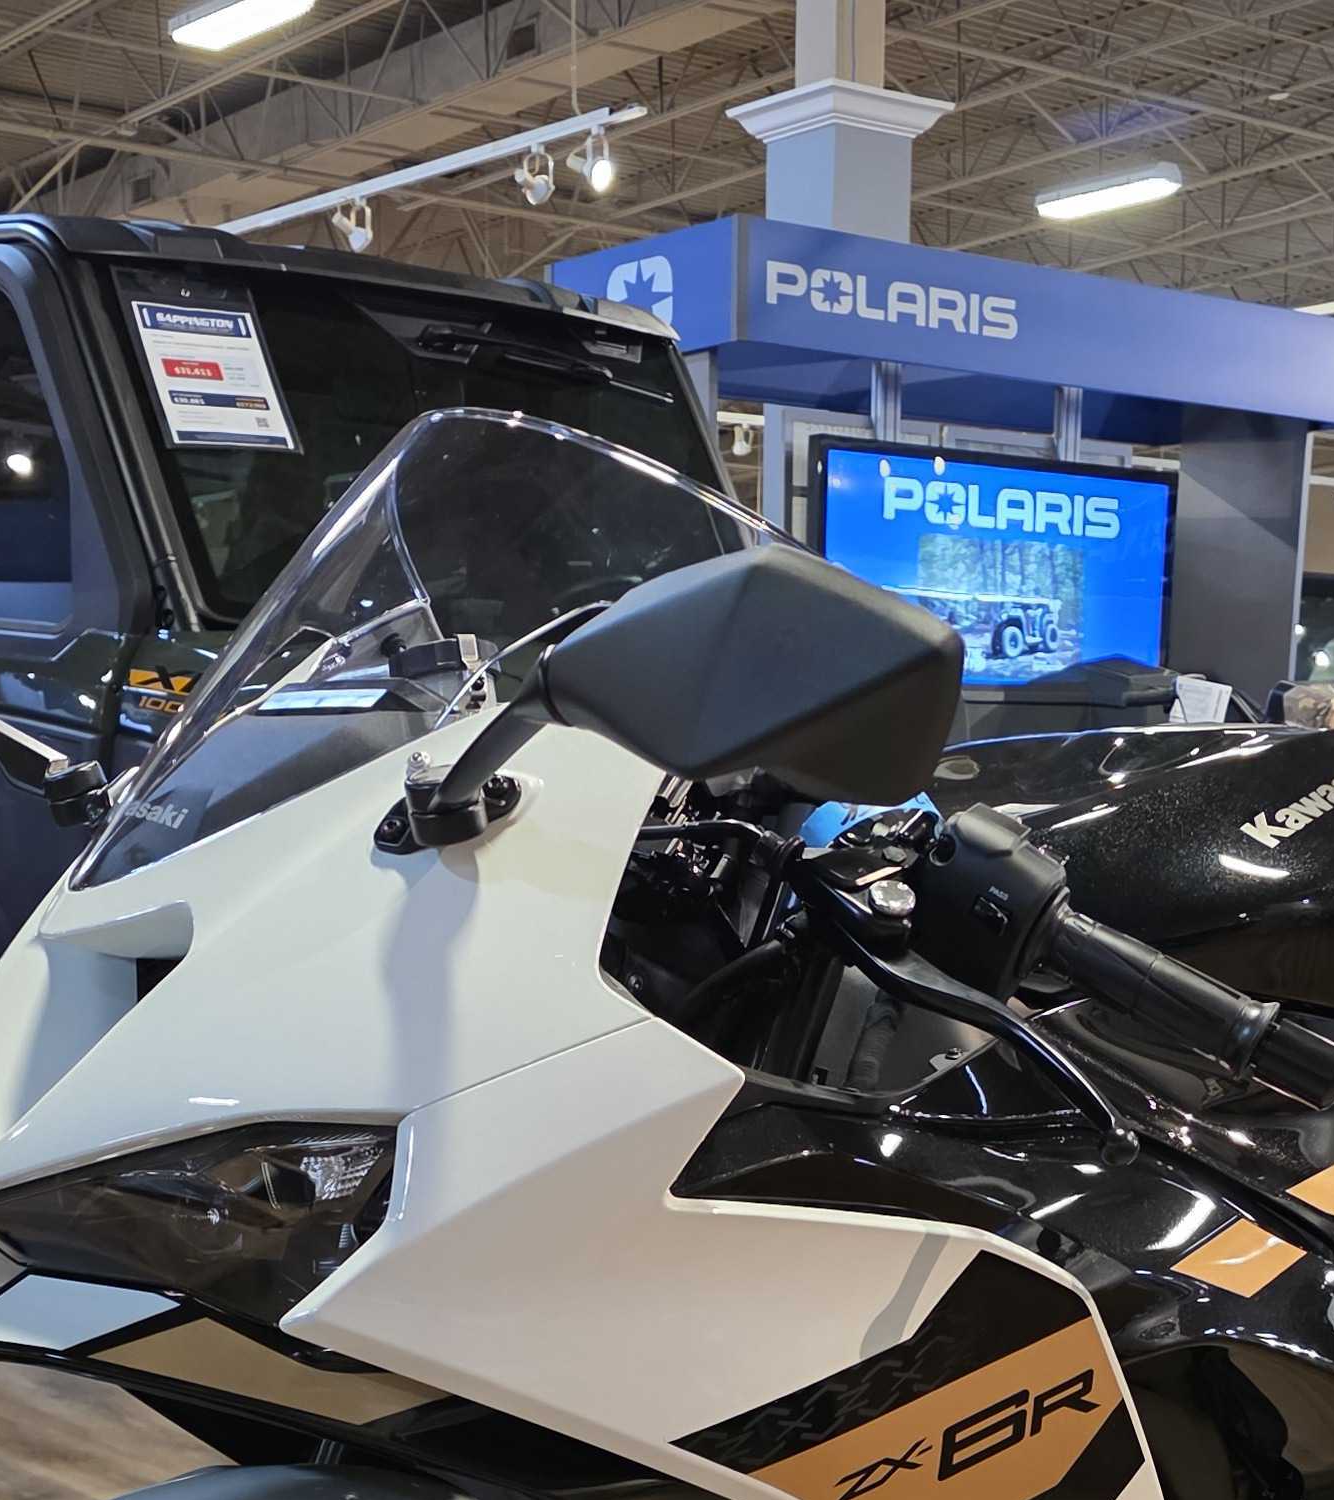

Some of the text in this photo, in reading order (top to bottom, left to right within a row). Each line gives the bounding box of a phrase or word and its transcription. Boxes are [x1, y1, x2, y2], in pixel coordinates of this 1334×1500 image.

[155, 312, 235, 329] SAPPINGTON
[766, 260, 1018, 340] POLARIS
[882, 476, 1120, 539] POLARIS
